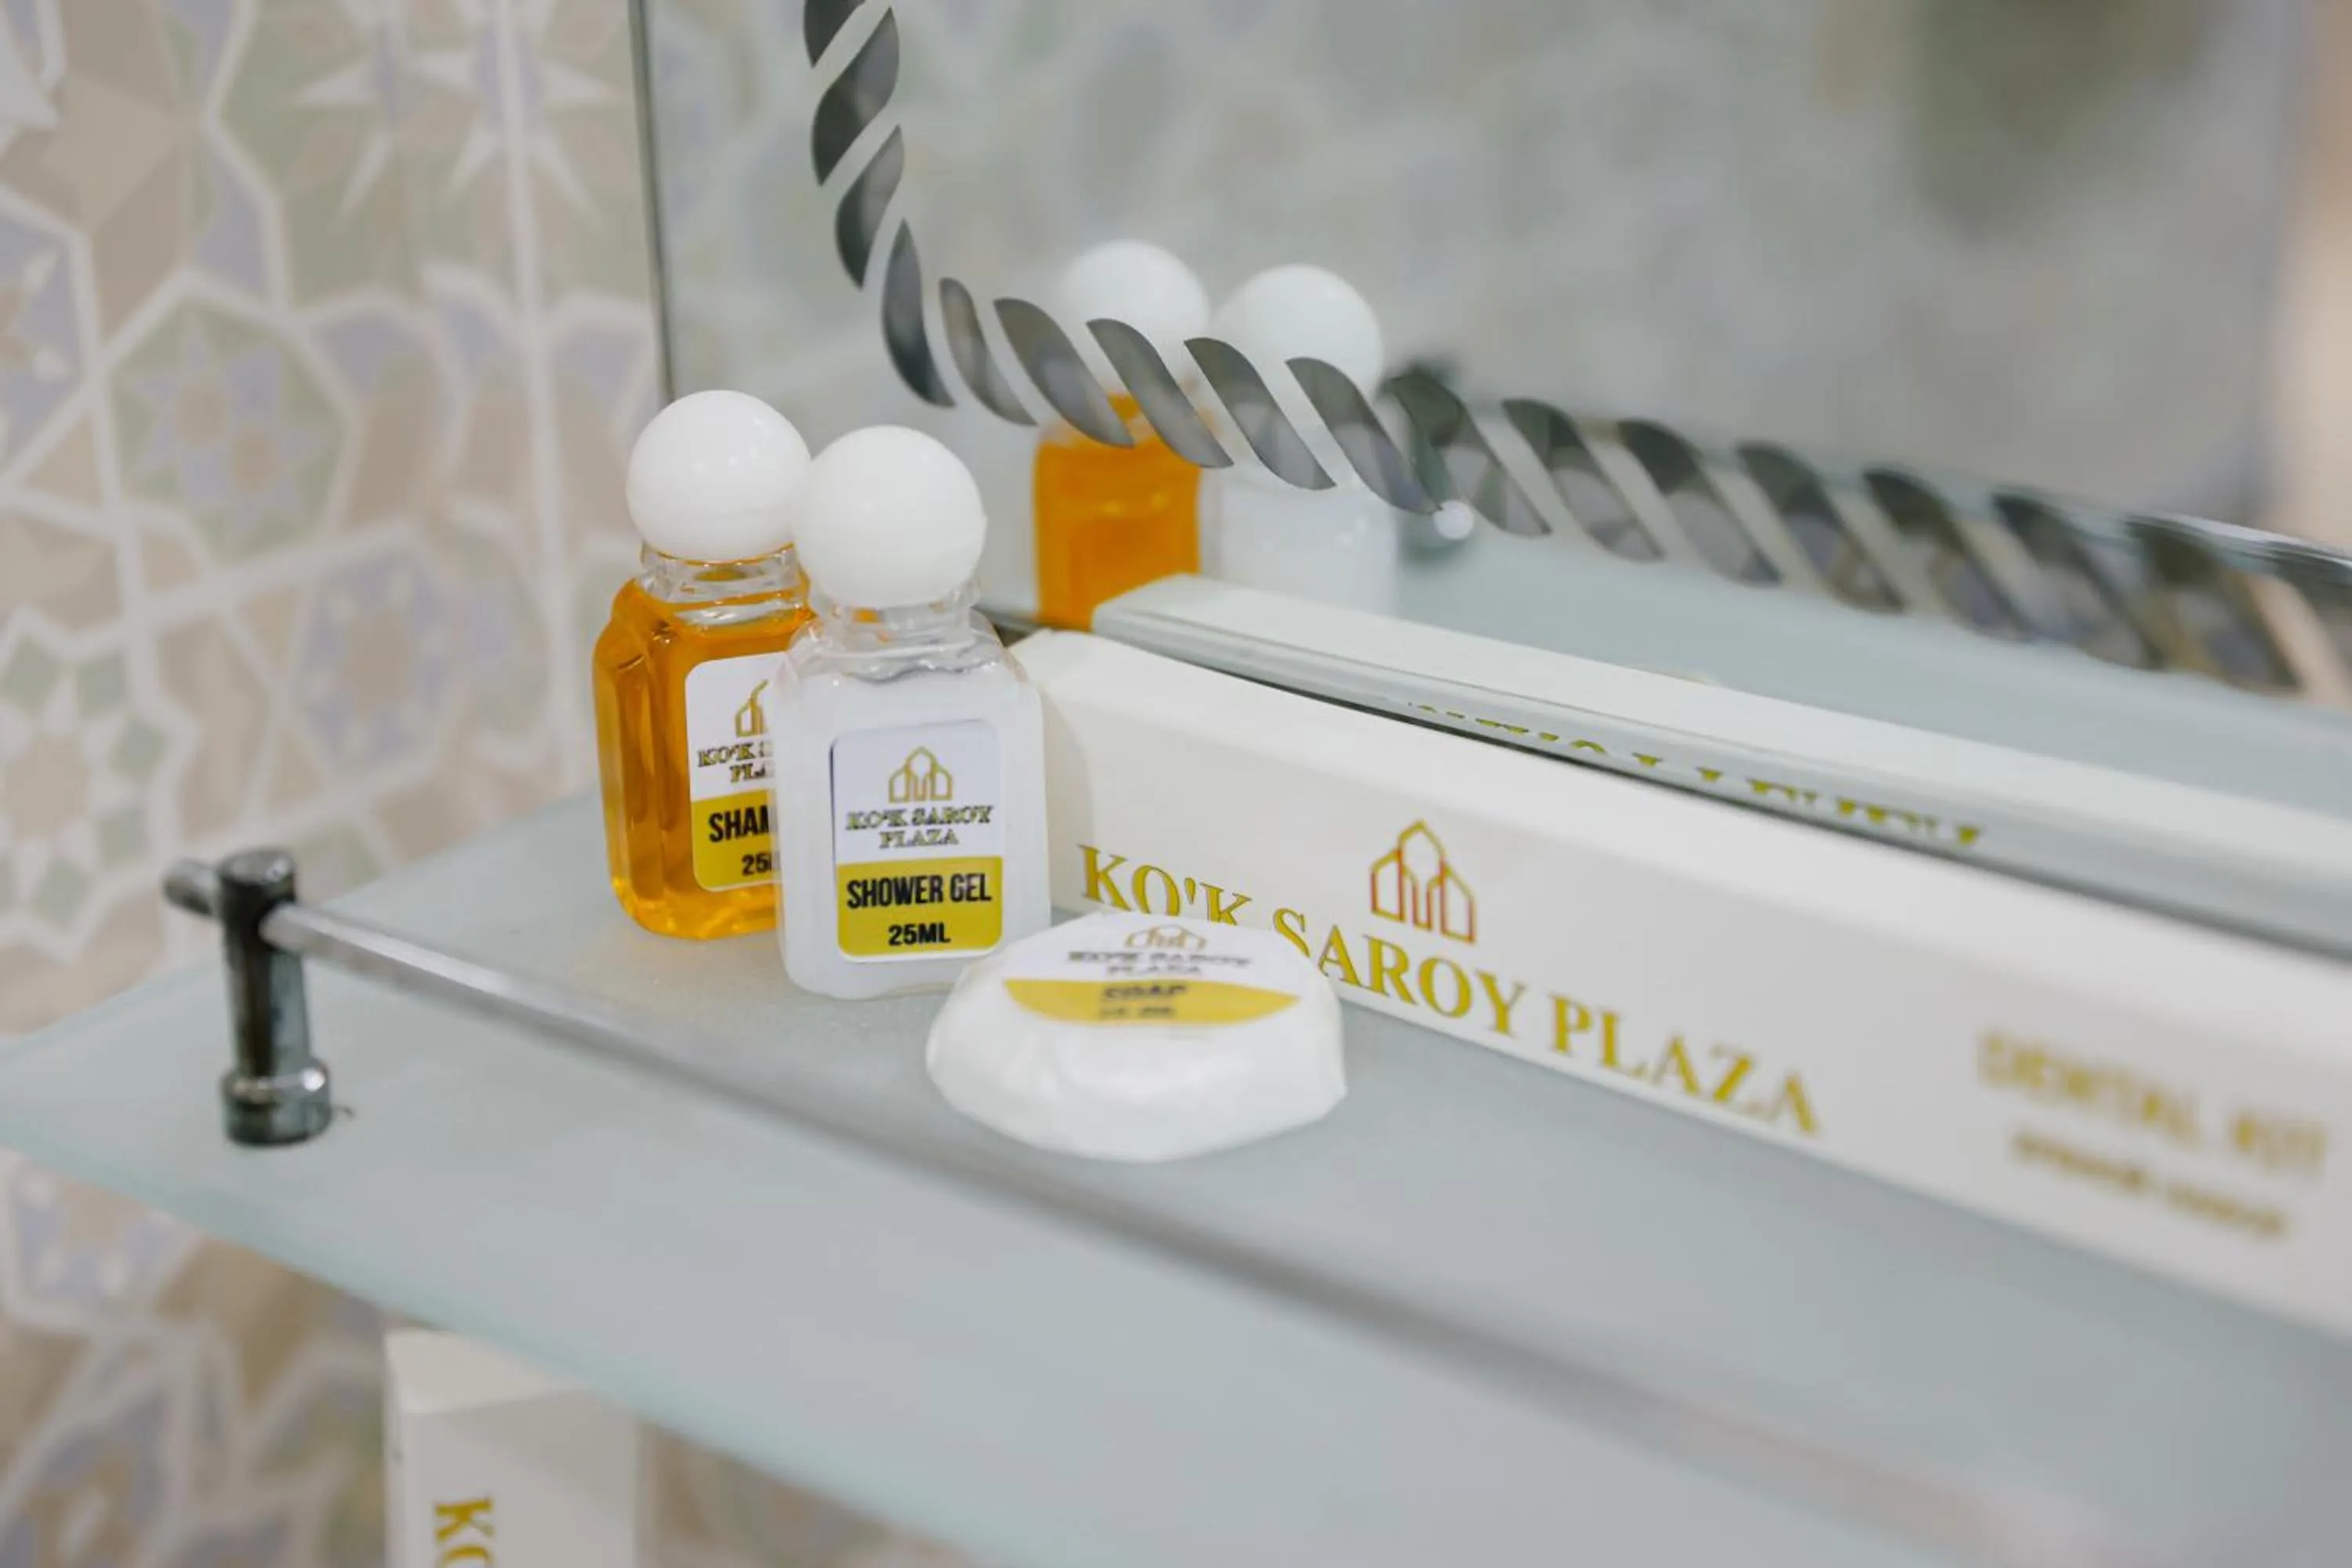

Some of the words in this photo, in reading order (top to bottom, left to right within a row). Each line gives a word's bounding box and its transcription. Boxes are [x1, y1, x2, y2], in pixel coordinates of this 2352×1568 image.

[912, 805, 993, 826] SAROY
[879, 828, 959, 849] PLAZA
[847, 874, 944, 909] SHOWER
[950, 873, 992, 902] GEL
[888, 923, 951, 946] 25ML
[1272, 907, 1525, 1038] SAROY
[1548, 993, 1820, 1136] PLAZA
